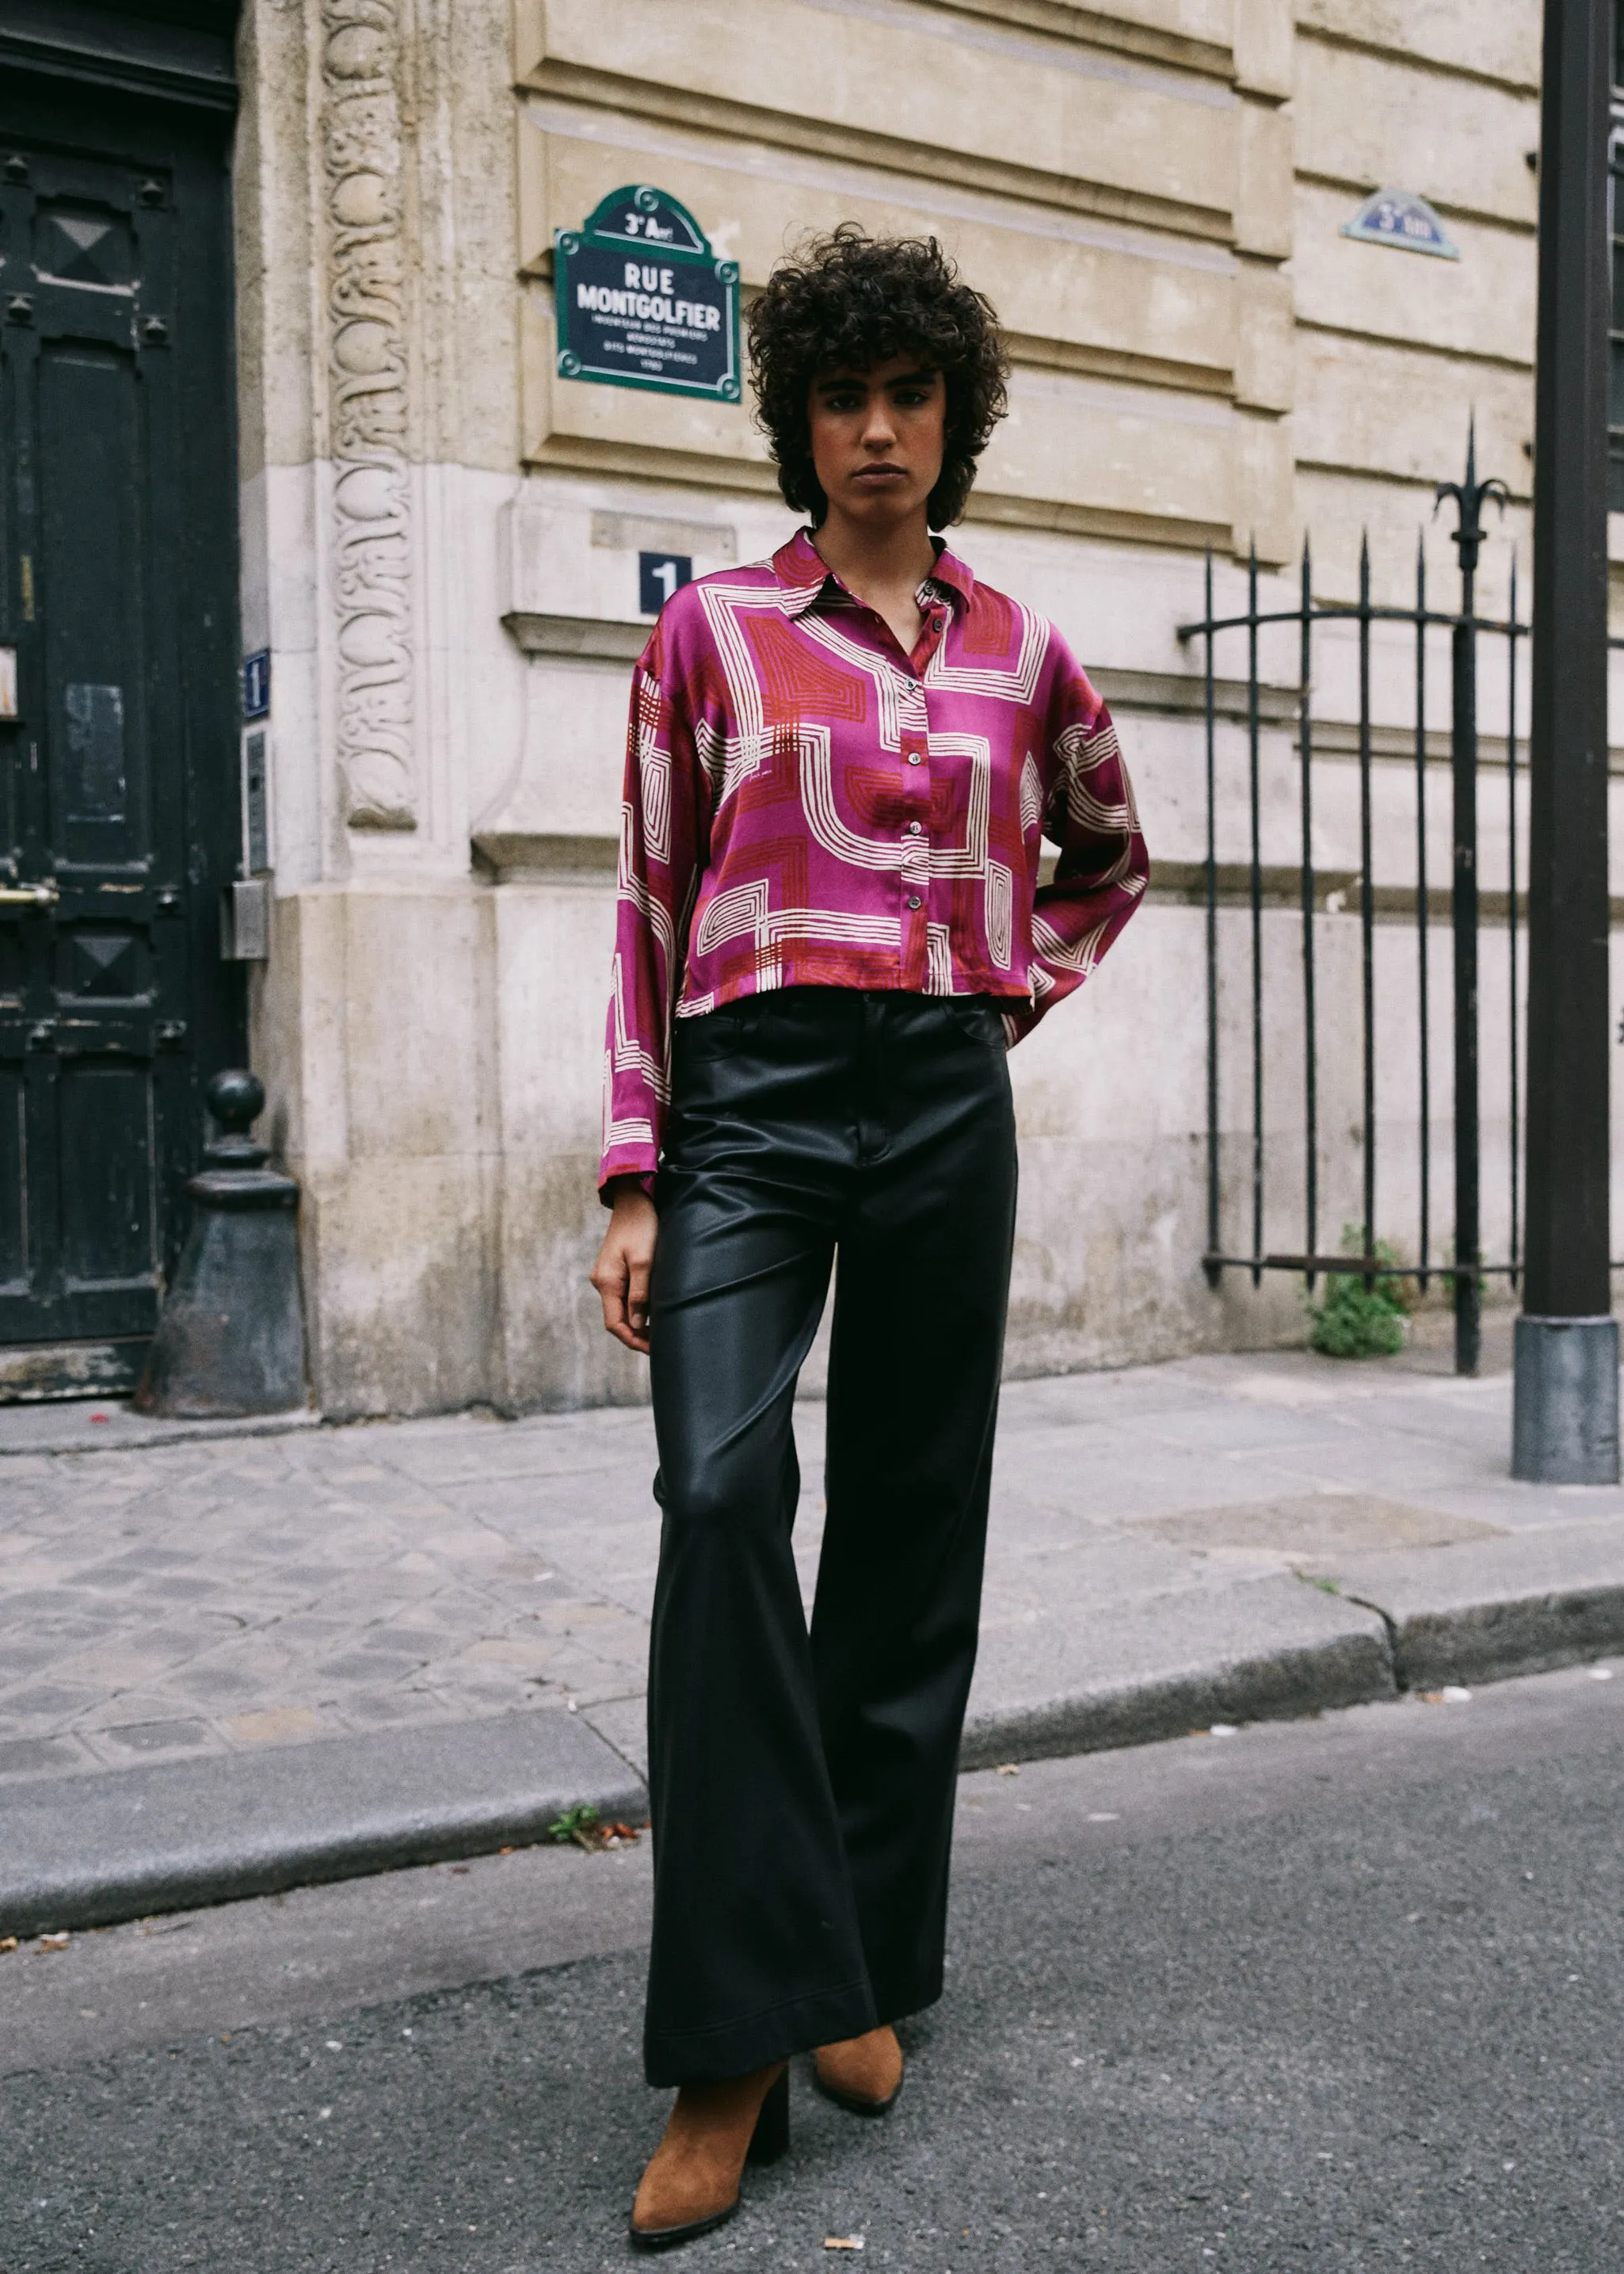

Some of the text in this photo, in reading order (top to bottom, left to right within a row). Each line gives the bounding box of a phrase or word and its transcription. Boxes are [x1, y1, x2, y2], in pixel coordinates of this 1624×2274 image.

[624, 262, 675, 296] RUE
[577, 283, 721, 331] MONTGOLFIER
[651, 560, 677, 602] 1
[251, 663, 260, 706] 1
